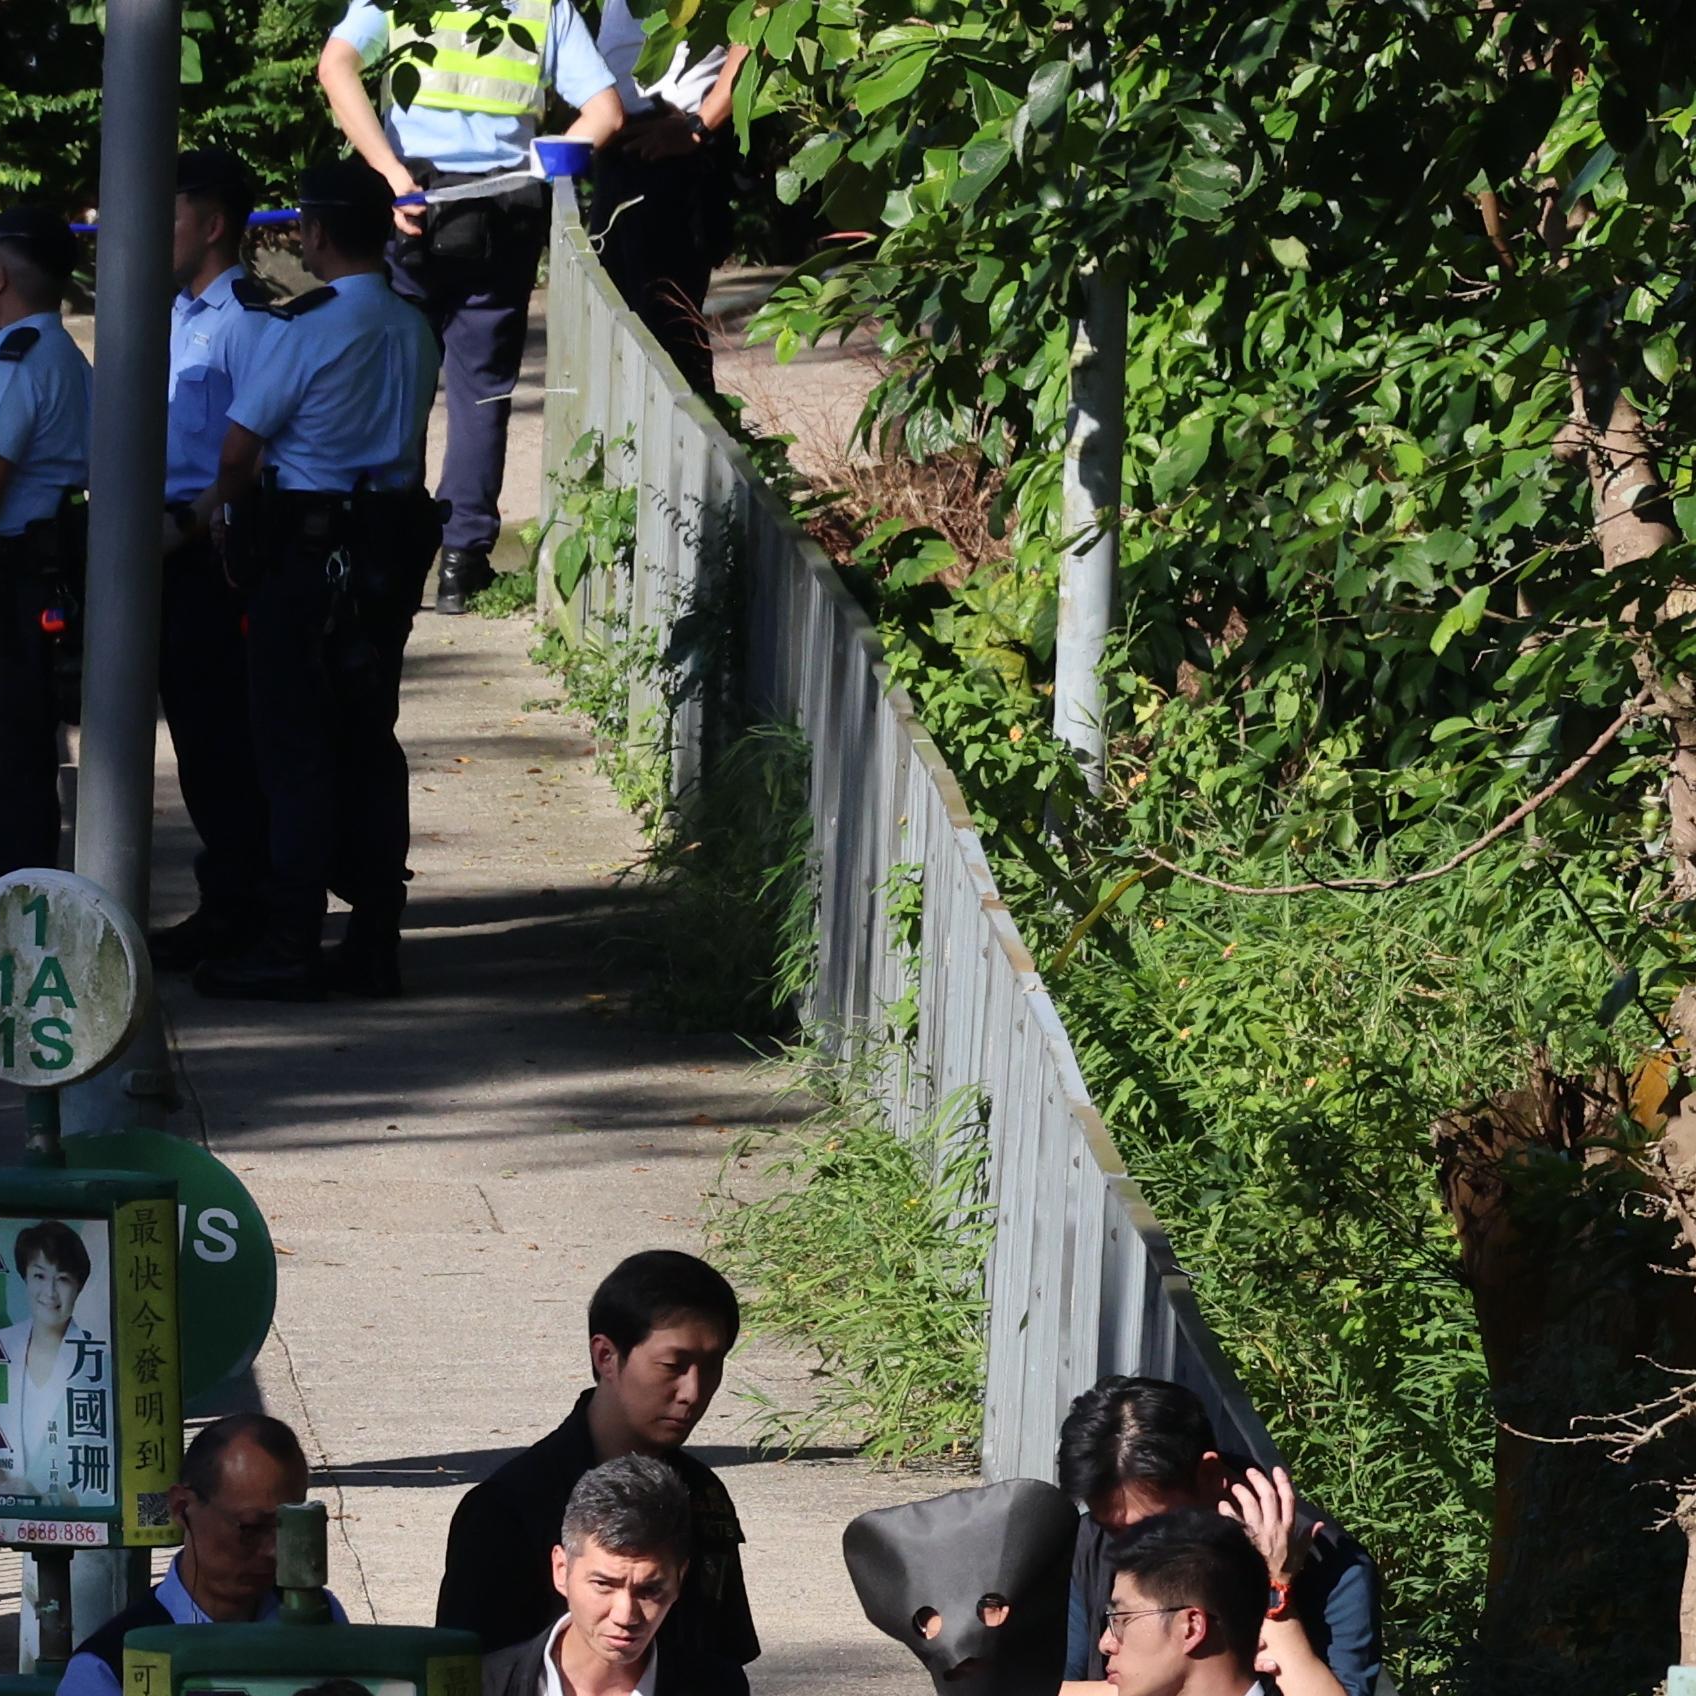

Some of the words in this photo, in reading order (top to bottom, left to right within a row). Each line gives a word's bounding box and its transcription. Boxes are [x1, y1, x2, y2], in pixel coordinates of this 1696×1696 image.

[22, 895, 47, 946] 1
[179, 1204, 239, 1262] S
[129, 1208, 167, 1474] 最快今發明到
[65, 1330, 111, 1497] 方國珊
